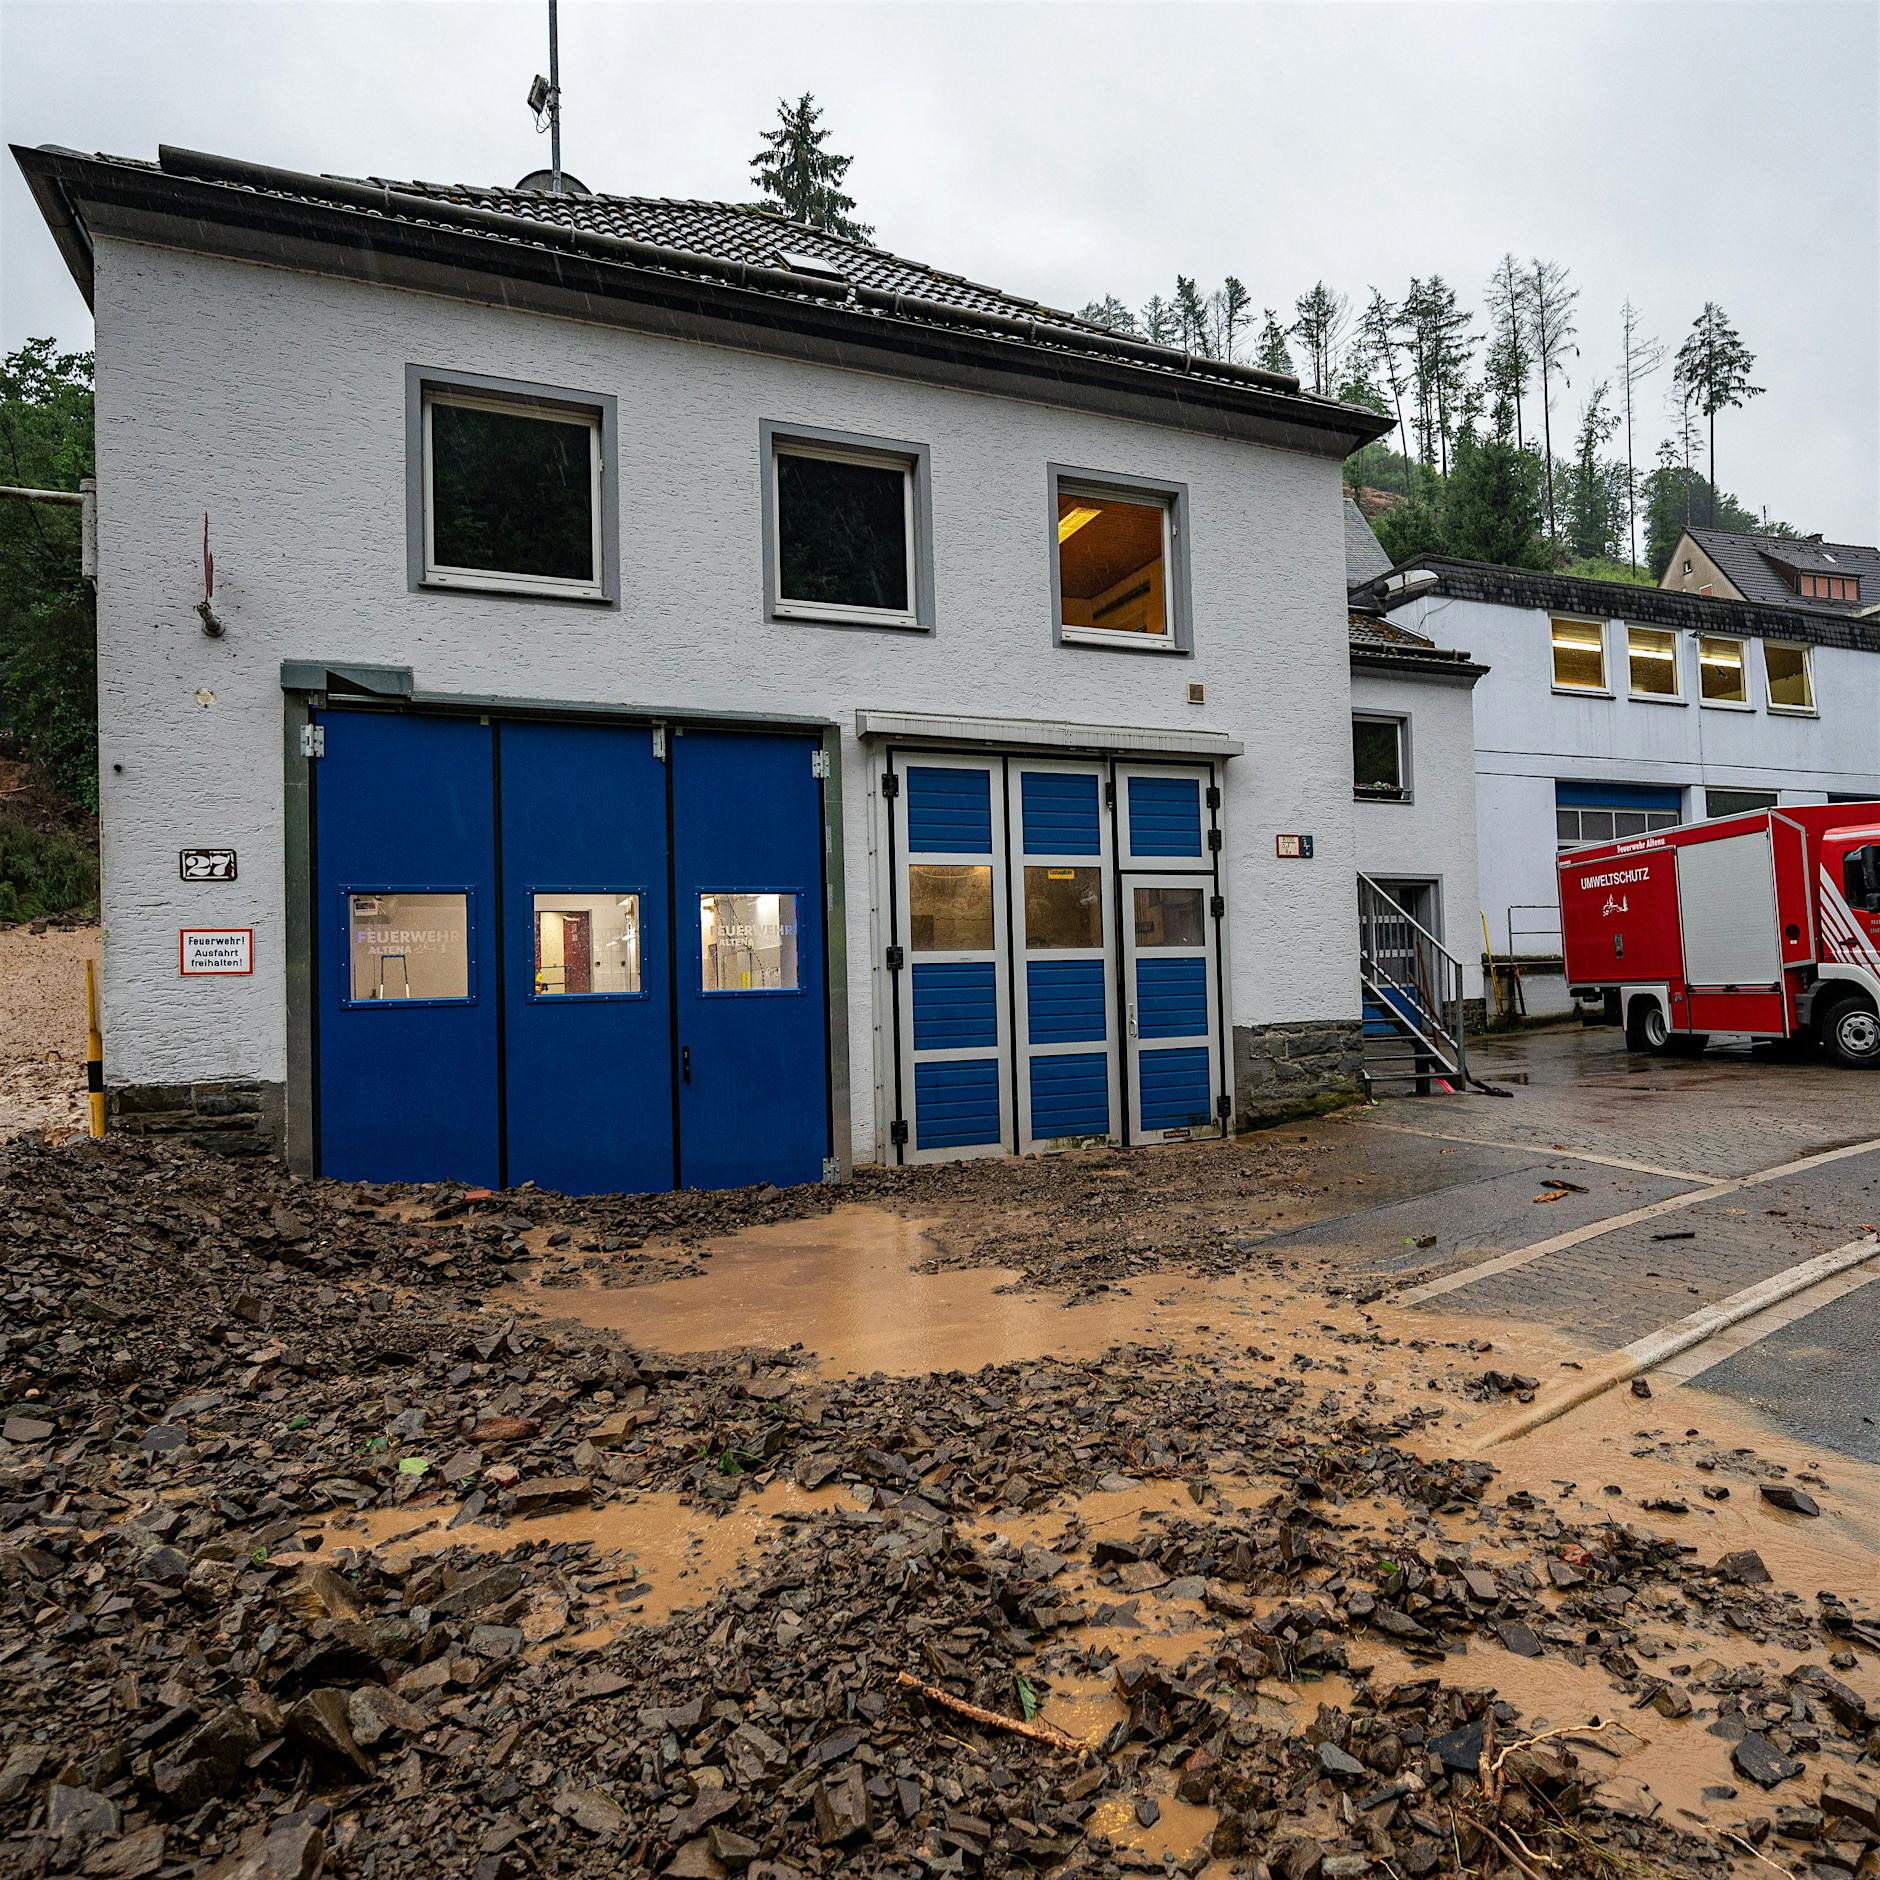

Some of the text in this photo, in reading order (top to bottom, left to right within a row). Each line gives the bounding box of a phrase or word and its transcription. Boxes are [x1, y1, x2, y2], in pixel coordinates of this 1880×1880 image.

[1617, 838, 1666, 854] Feuerwehr Altena
[185, 855, 230, 876] 27
[1580, 867, 1649, 889] UMWELTSCHUTZ
[188, 936, 245, 945] Feuerwehr!
[357, 930, 459, 943] FEUERWEHR
[194, 949, 239, 957] Ausfahrt
[368, 945, 412, 954] ALTENA
[191, 958, 242, 967] freihalten!
